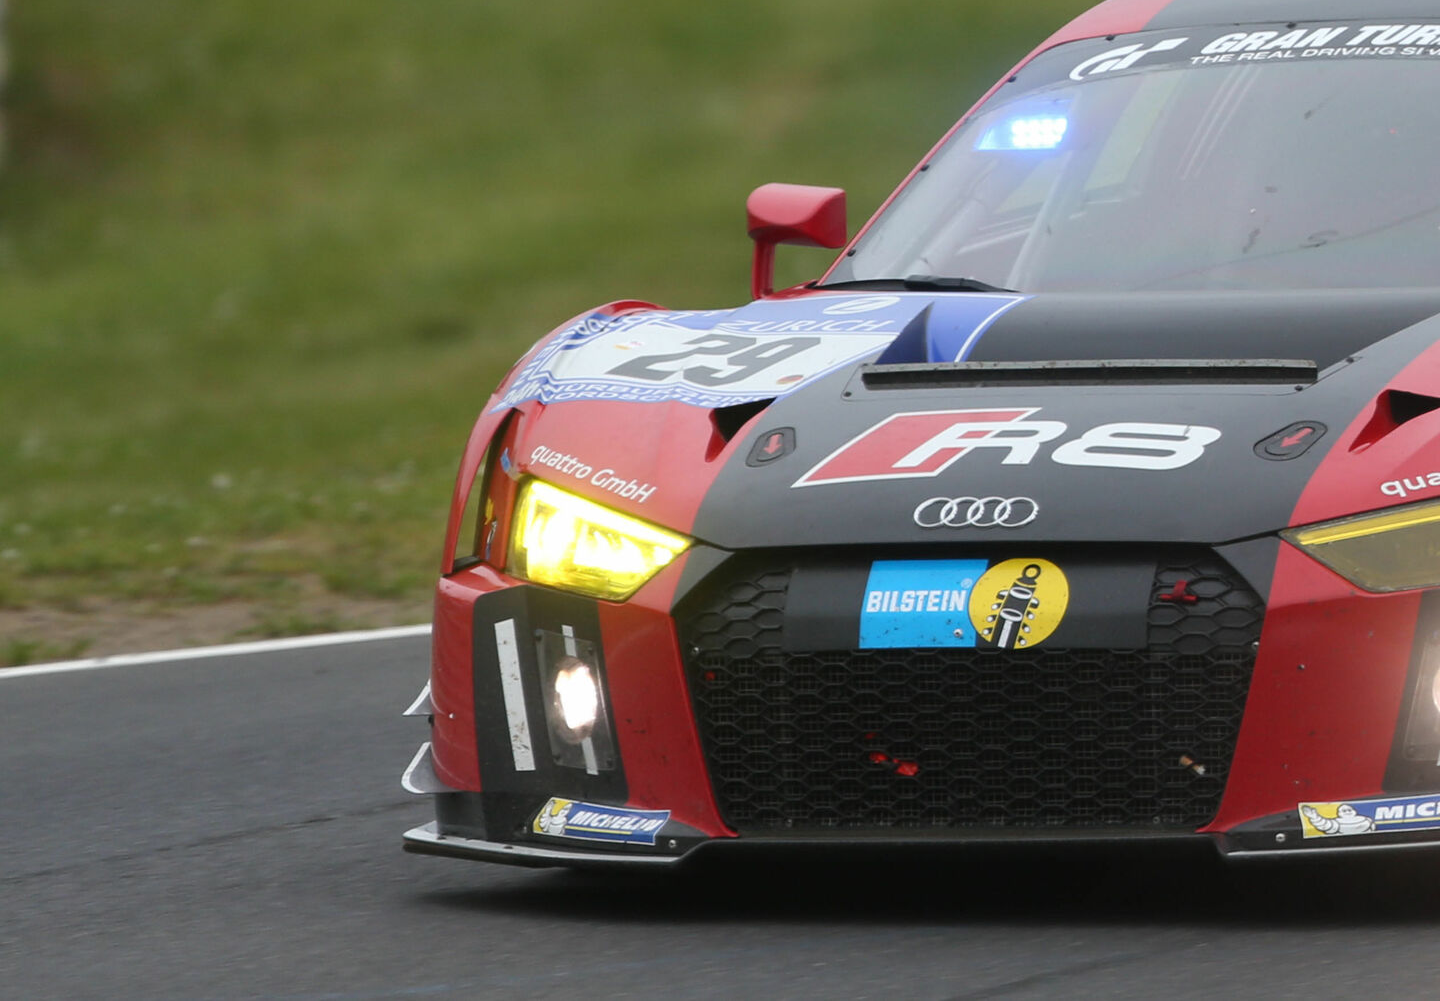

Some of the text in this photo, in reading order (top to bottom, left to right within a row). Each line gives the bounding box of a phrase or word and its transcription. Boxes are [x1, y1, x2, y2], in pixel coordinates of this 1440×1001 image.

[1200, 26, 1348, 55] GRAN
[1190, 53, 1235, 65] THE
[1236, 49, 1297, 62] REAL
[1301, 46, 1397, 58] DRIVING
[603, 333, 822, 388] 29
[890, 420, 1222, 471] R8
[530, 445, 657, 503] quattro GmbH
[865, 589, 968, 613] BILSTEIN
[568, 810, 665, 832] MICHELIN
